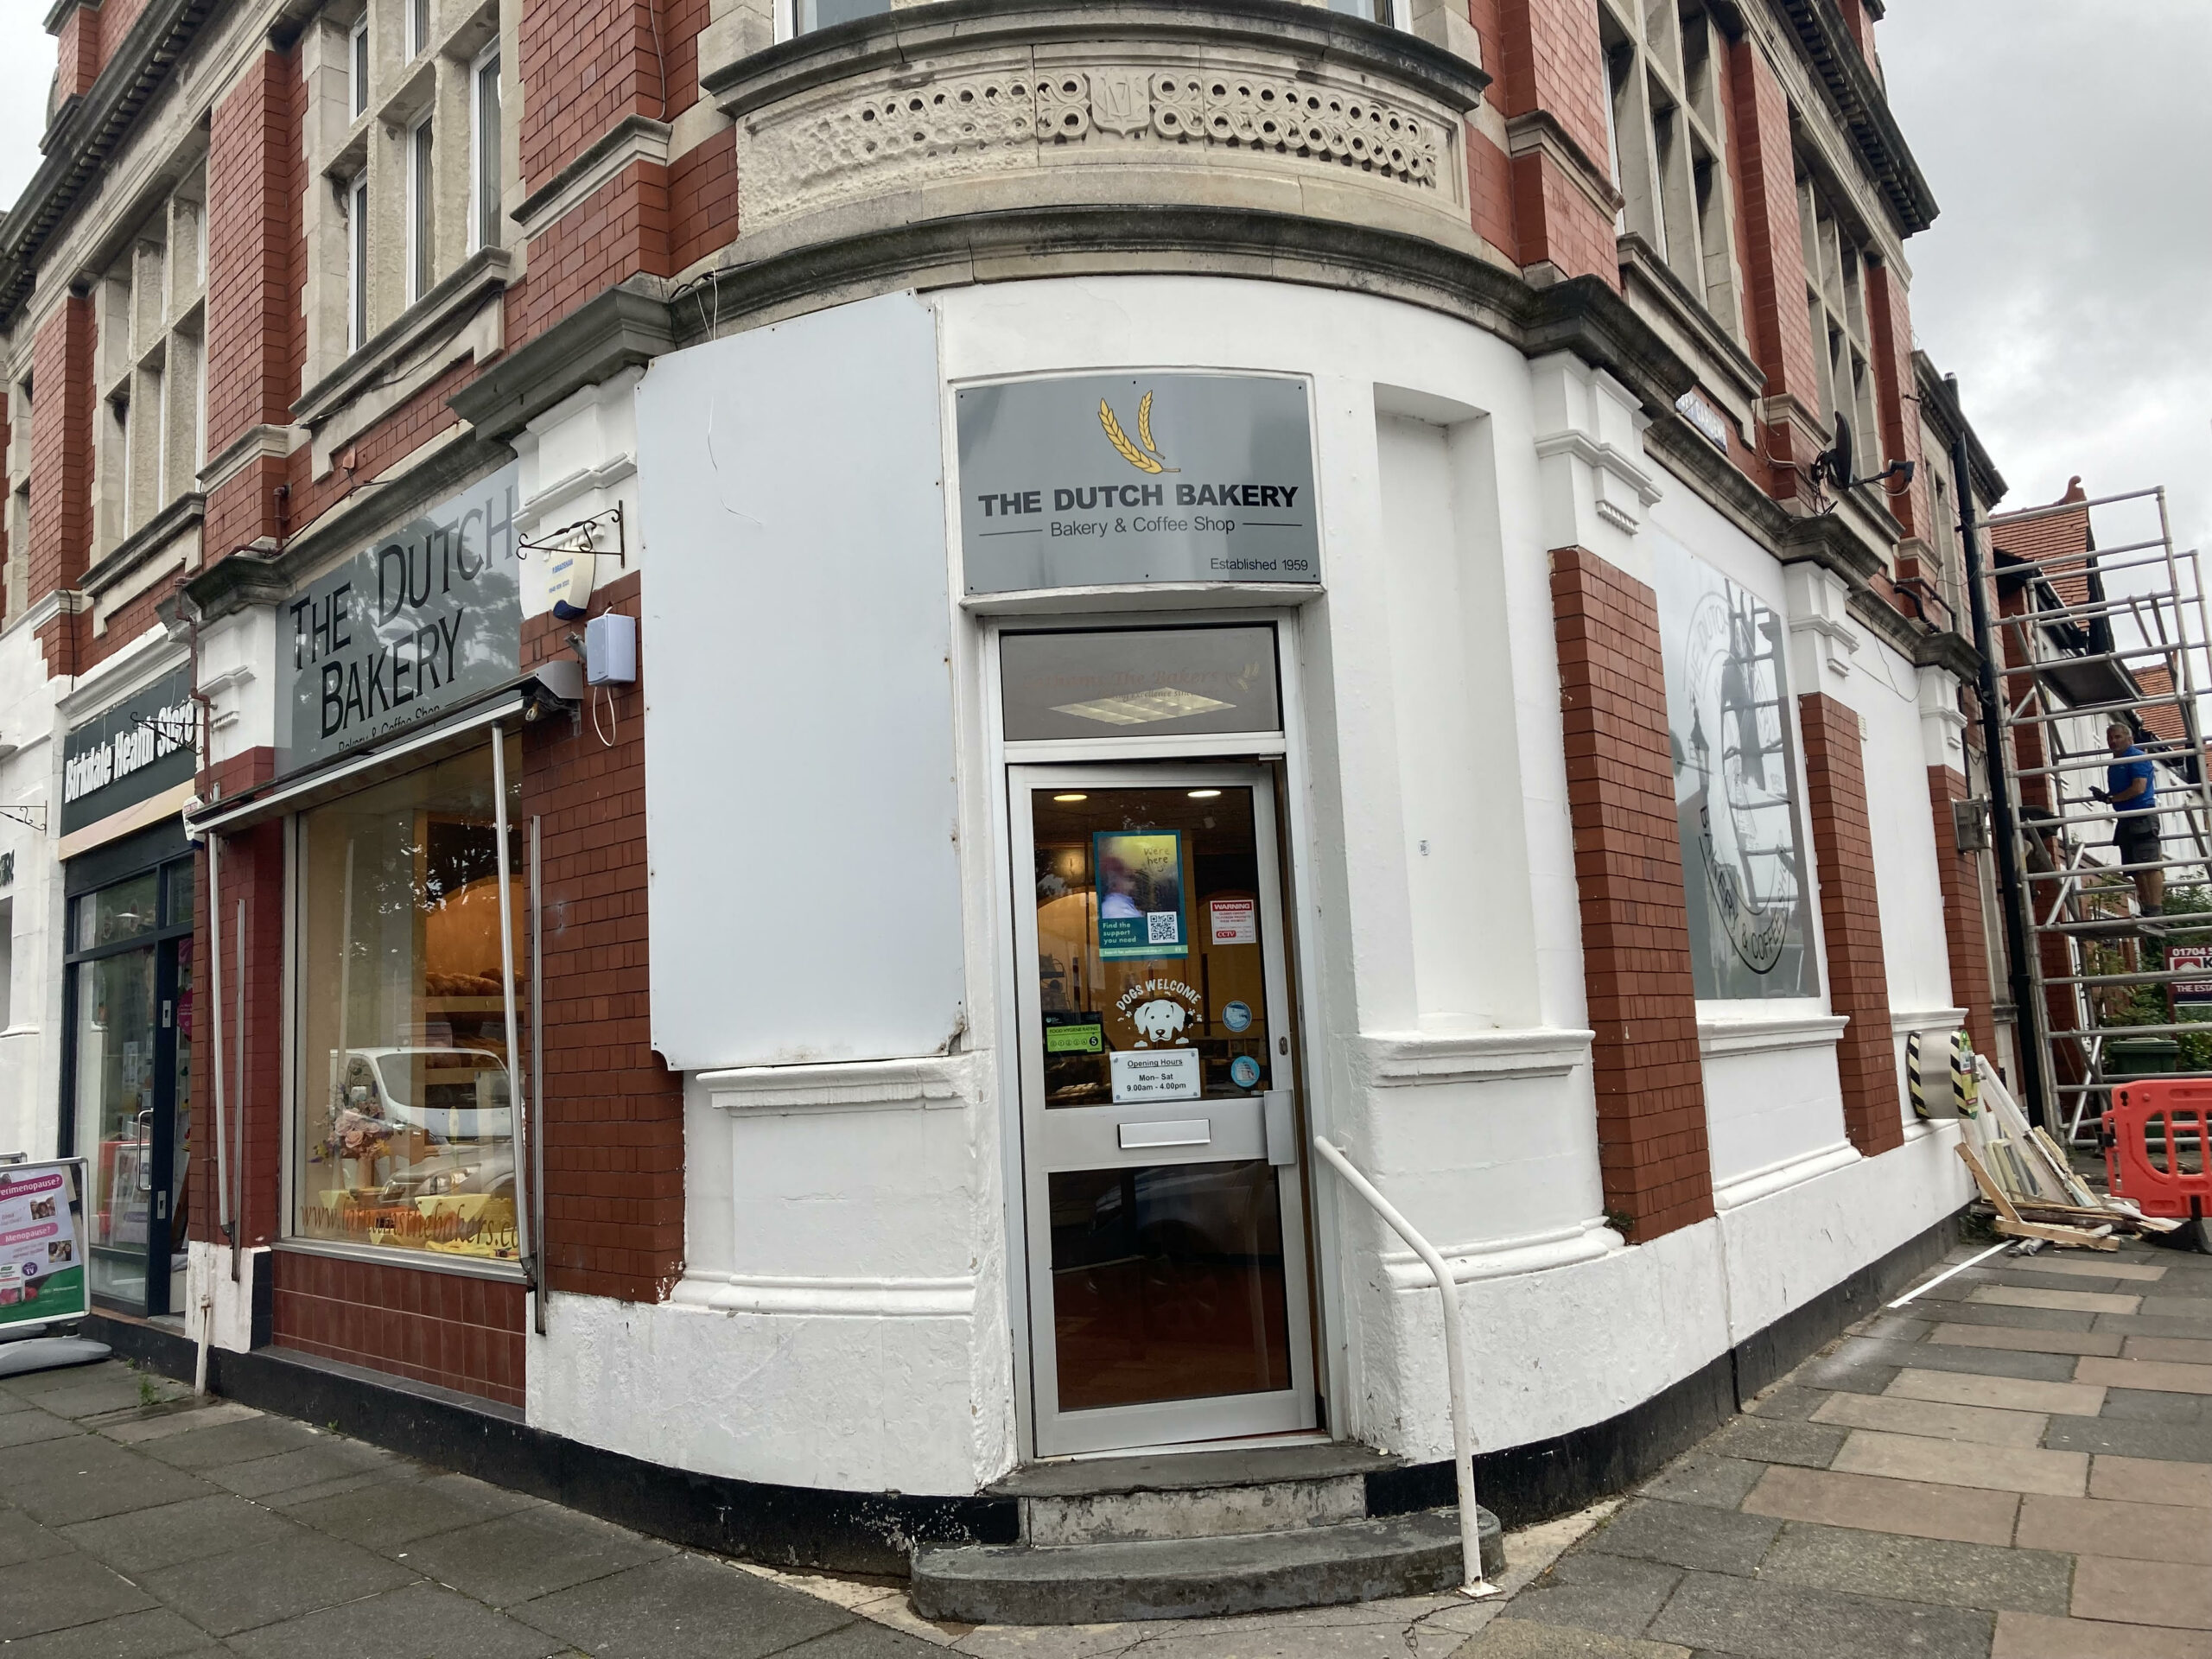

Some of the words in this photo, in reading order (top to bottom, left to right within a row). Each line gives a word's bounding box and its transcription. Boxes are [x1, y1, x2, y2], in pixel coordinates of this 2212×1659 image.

[978, 491, 1042, 517] THE
[1054, 484, 1164, 512] DUTCH
[1176, 484, 1299, 508] BAKERY
[1051, 520, 1108, 537] Bakery
[1114, 518, 1128, 534] &
[1133, 516, 1188, 533] Coffee
[1194, 517, 1236, 536] Shop
[1210, 557, 1277, 571] Established
[1281, 559, 1308, 571] 1959
[290, 582, 351, 671] THE
[378, 486, 513, 627] DUTCH
[321, 607, 464, 740] BAKERY
[65, 741, 112, 804] Birkdale
[156, 701, 194, 758] Store
[1147, 856, 1168, 865] here
[2172, 947, 2206, 957] 01704
[1116, 984, 1144, 1011] DOGS
[1145, 978, 1202, 1004] WELCOME
[1127, 1059, 1159, 1068] Opening
[1126, 1084, 1154, 1092] 9.00am
[1160, 1083, 1186, 1091] 4.00pm
[5, 1226, 51, 1243] Menopause?
